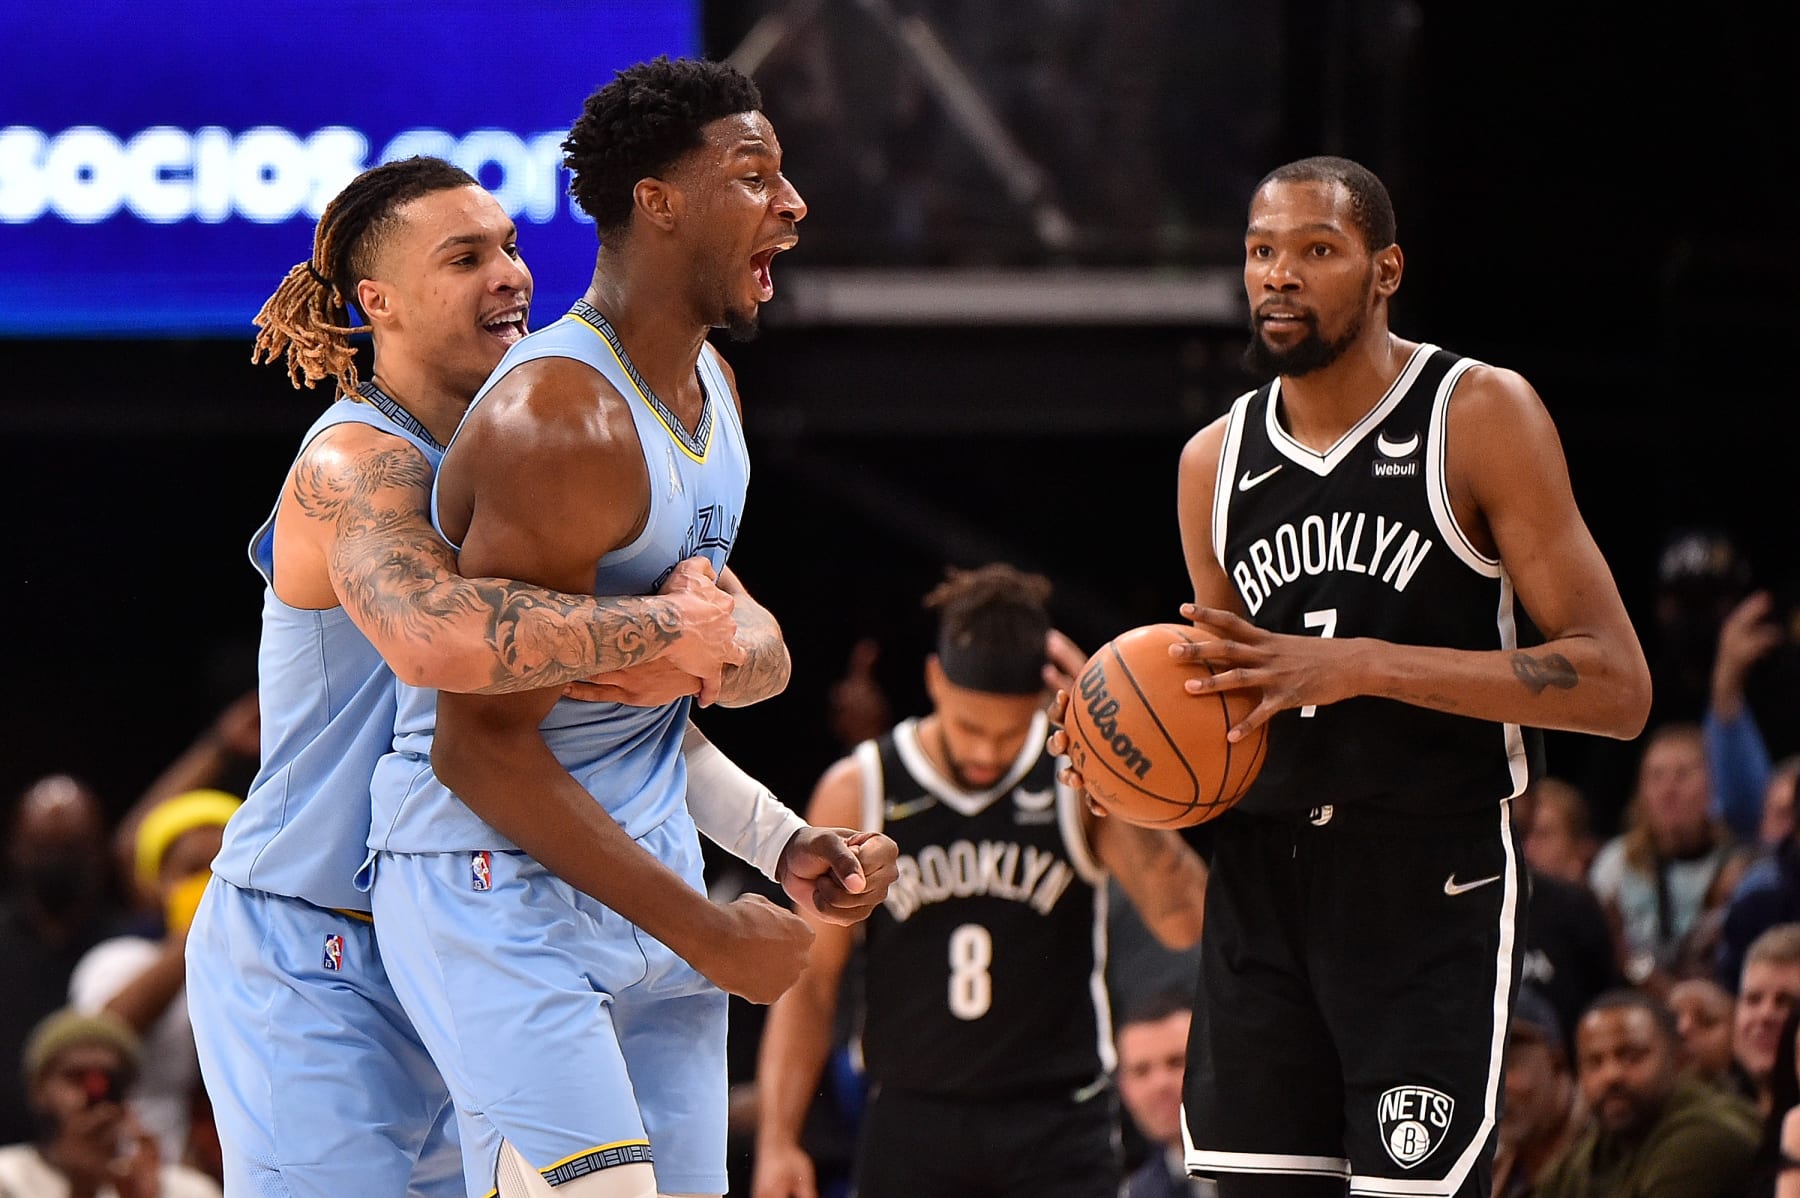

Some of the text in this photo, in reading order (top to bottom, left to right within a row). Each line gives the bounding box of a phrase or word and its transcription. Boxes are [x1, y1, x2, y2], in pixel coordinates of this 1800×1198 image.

[1374, 463, 1416, 476] Webull
[1234, 512, 1433, 616] BROOKLYN
[1300, 608, 1337, 718] 7
[1080, 658, 1152, 780] Wilson
[949, 922, 993, 1021] 8
[1381, 1090, 1448, 1128] NETS
[1403, 1127, 1416, 1155] B
